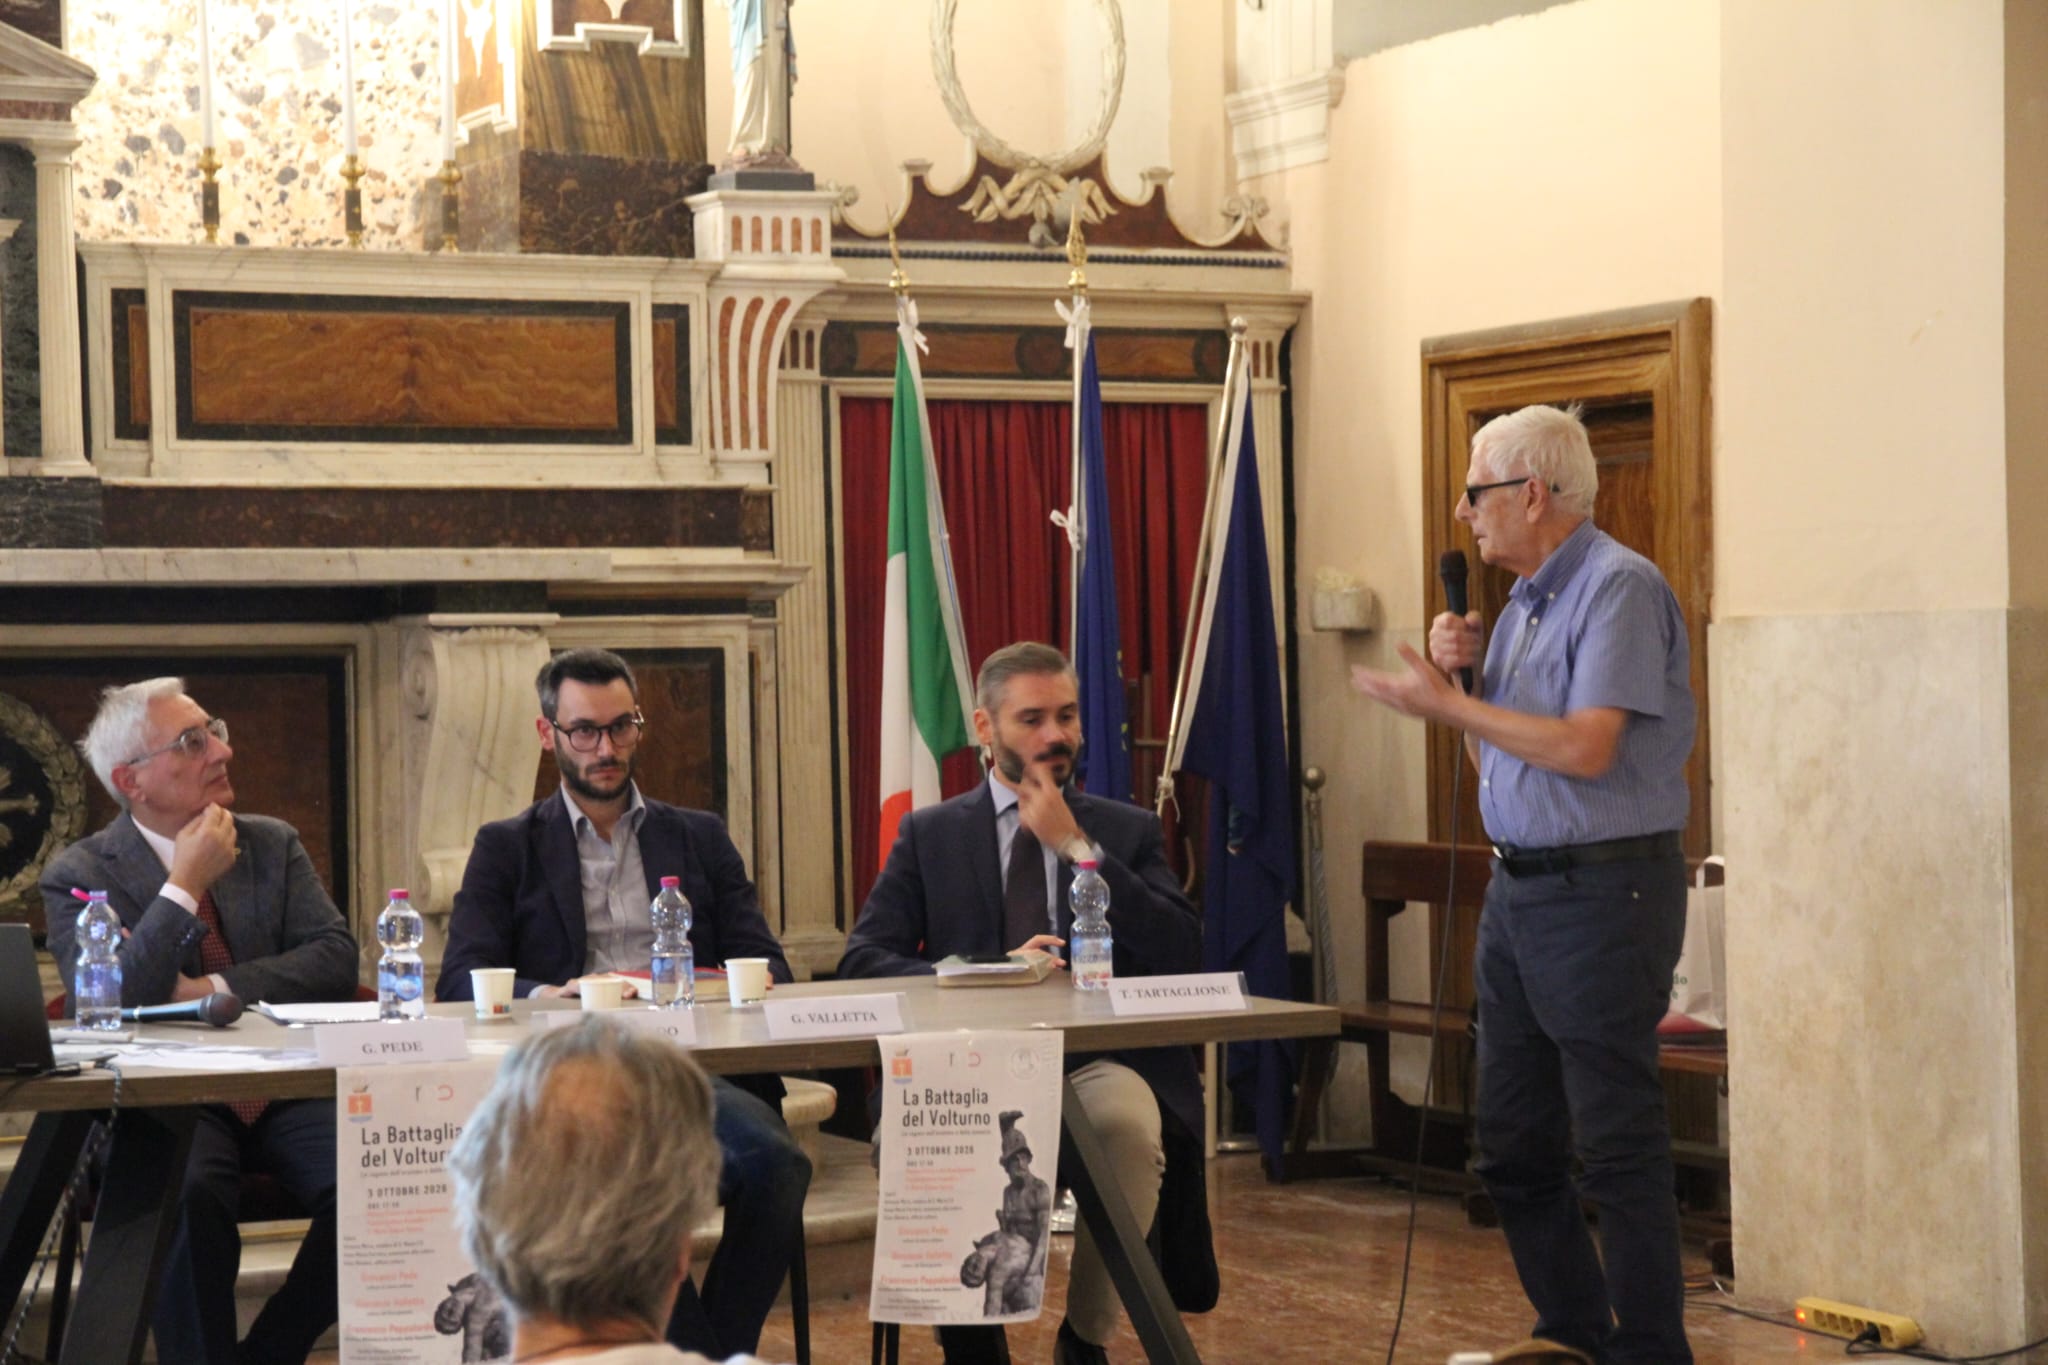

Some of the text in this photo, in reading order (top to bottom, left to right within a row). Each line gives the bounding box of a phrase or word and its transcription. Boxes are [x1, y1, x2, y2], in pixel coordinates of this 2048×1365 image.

[1119, 985, 1231, 999] T. TARTAGLIONE
[791, 1011, 878, 1024] G. VALLETTA
[362, 1041, 423, 1054] G. PEDE
[903, 1087, 989, 1108] La Battaglia
[902, 1109, 991, 1127] del Volturno
[361, 1127, 381, 1145] La
[361, 1146, 448, 1168] del Voltur
[915, 1145, 951, 1156] OTTOBRE
[377, 1185, 420, 1198] OTTOBRE
